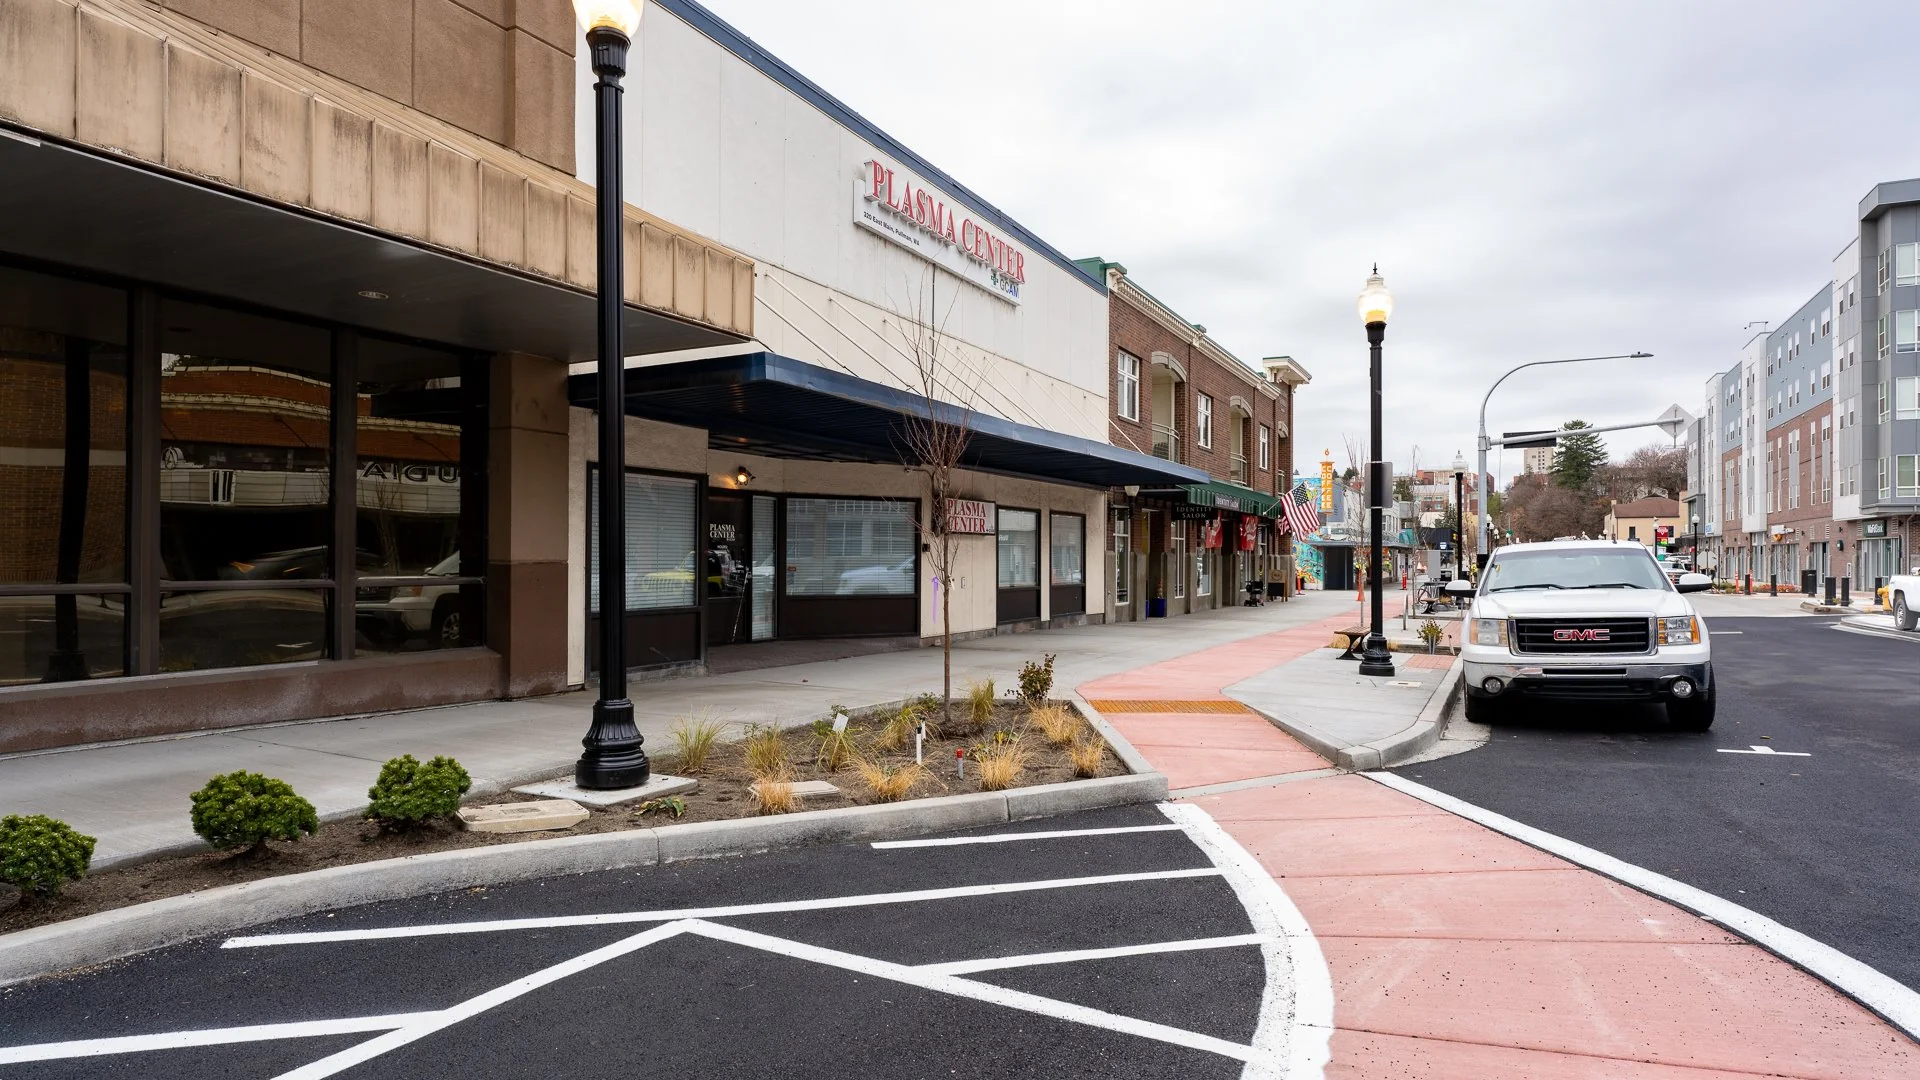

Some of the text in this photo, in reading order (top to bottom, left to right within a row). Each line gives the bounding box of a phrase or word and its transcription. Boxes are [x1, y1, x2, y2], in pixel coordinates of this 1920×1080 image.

[870, 158, 1026, 284] PLASMA CENTER
[872, 215, 883, 227] East
[883, 221, 895, 234] Main,
[895, 228, 913, 243] Pullman,
[913, 238, 920, 246] WA
[999, 278, 1020, 299] GCAM
[946, 499, 987, 517] PLASMA
[709, 523, 736, 532] PLASMA
[946, 515, 986, 533] CENTER
[709, 530, 735, 539] CENTER
[1553, 629, 1611, 641] GMC
